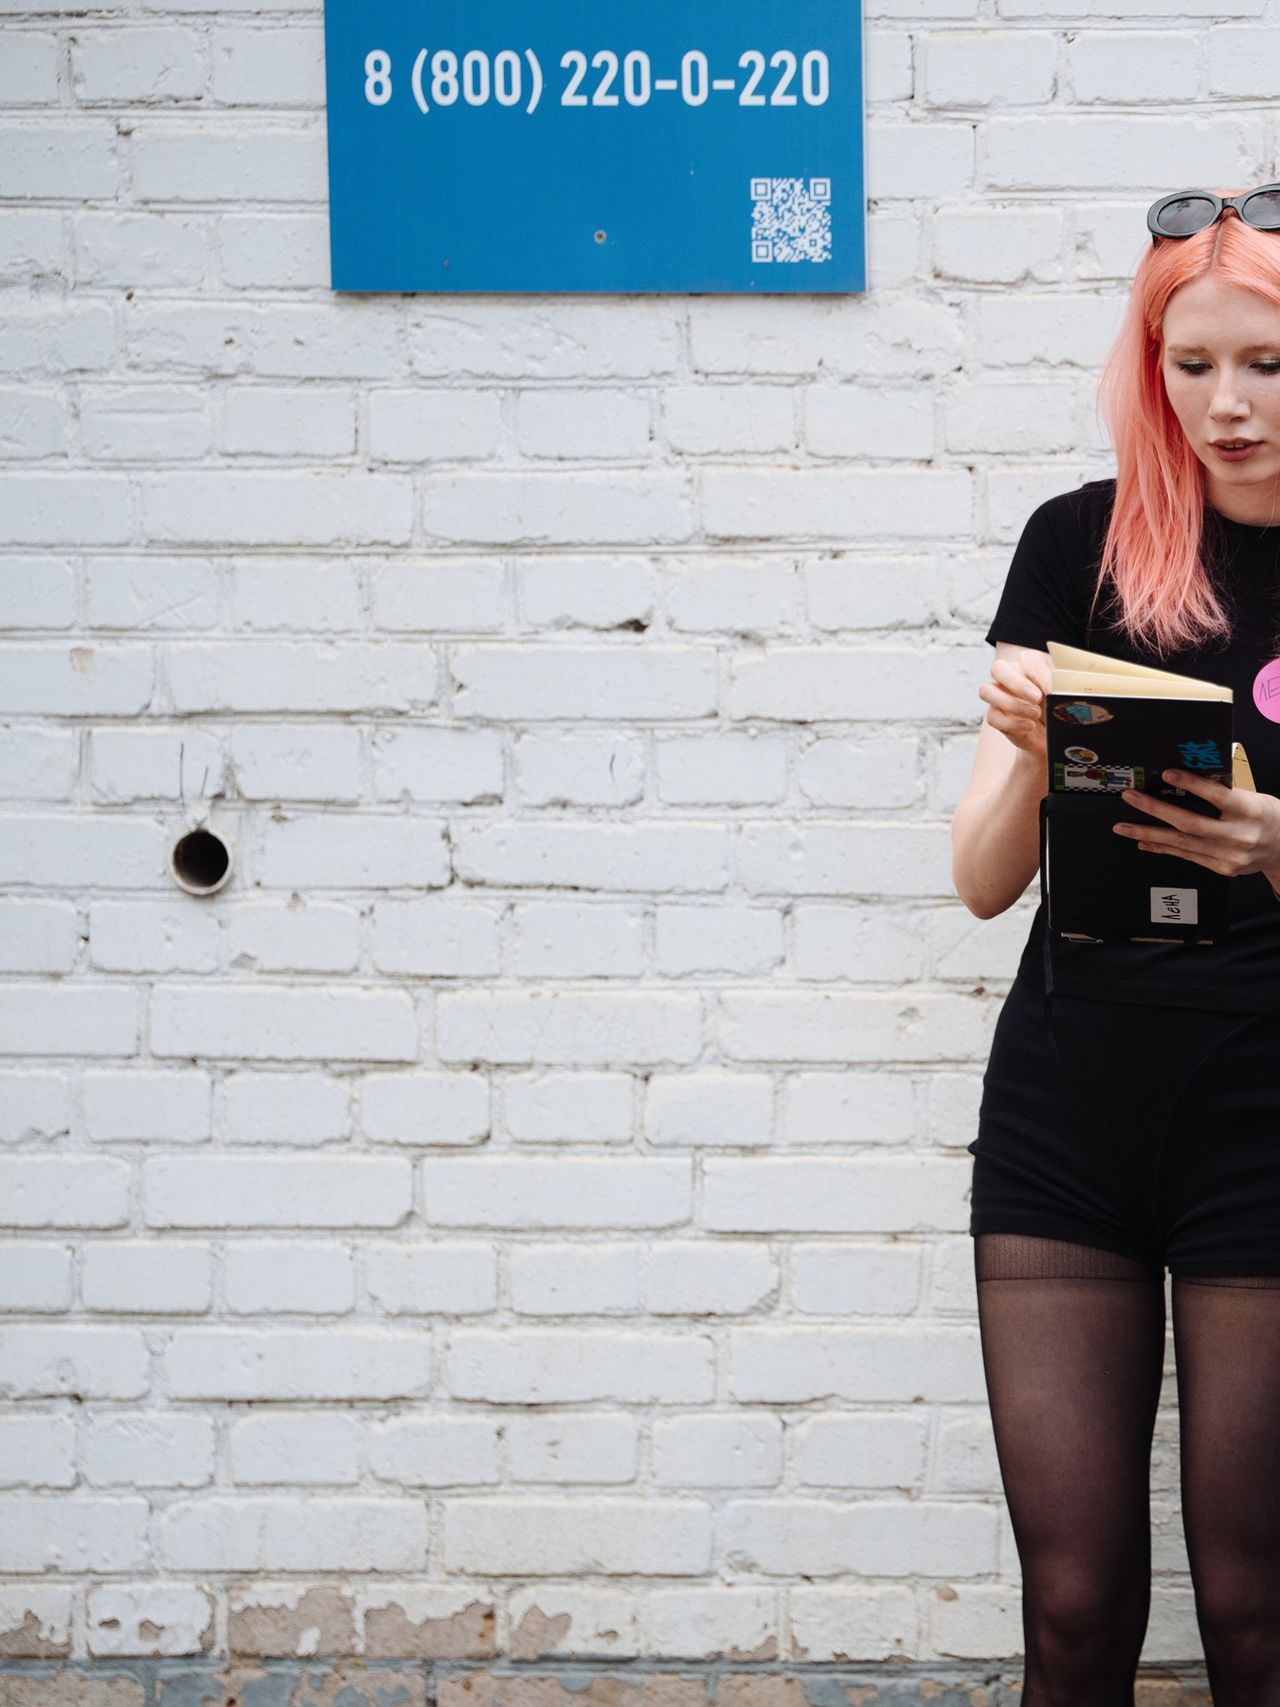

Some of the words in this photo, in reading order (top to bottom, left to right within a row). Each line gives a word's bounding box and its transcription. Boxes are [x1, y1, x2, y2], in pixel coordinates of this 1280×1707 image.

[364, 49, 392, 107] 8
[411, 47, 543, 115] (800)
[559, 49, 830, 107] 220-0-220
